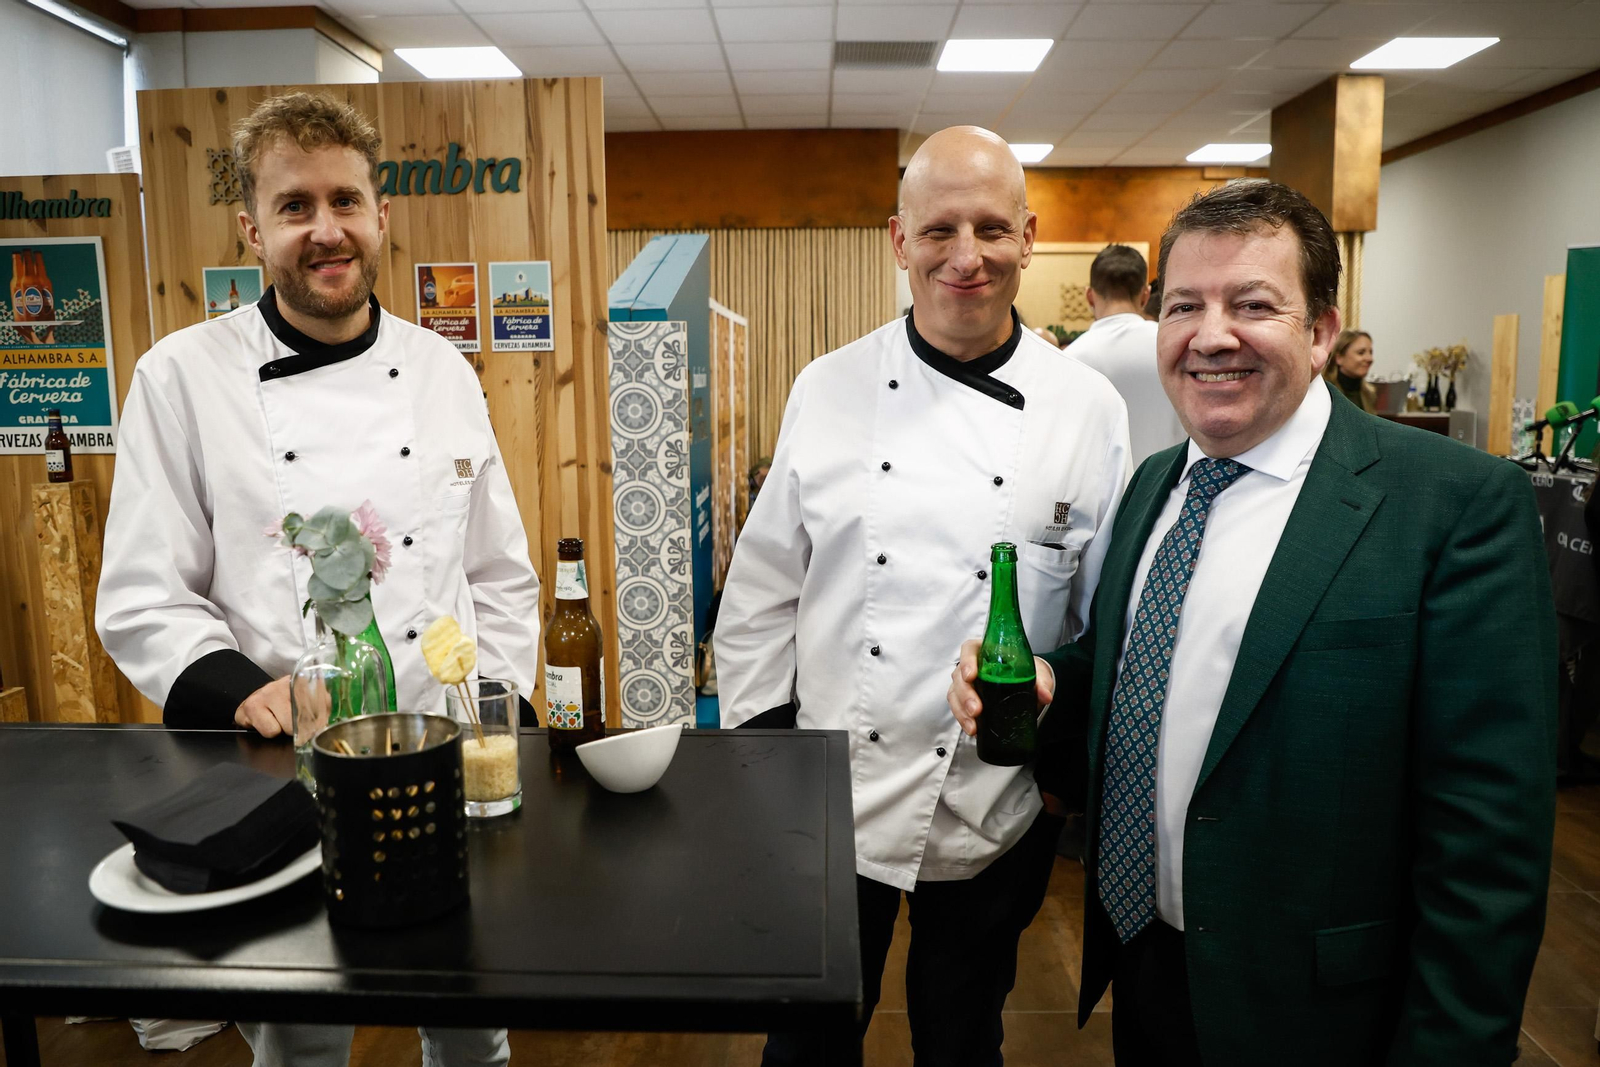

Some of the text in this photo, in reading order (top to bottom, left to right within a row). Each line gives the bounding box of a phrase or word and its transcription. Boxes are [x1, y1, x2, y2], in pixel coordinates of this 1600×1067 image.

[378, 142, 522, 196] ambra
[521, 341, 551, 349] ALHAMBRA
[3, 352, 103, 365] ALHAMBRA S.A.
[0, 371, 92, 389] Fábrica de
[9, 388, 84, 405] Cerveza
[0, 433, 42, 448] RVEZAS
